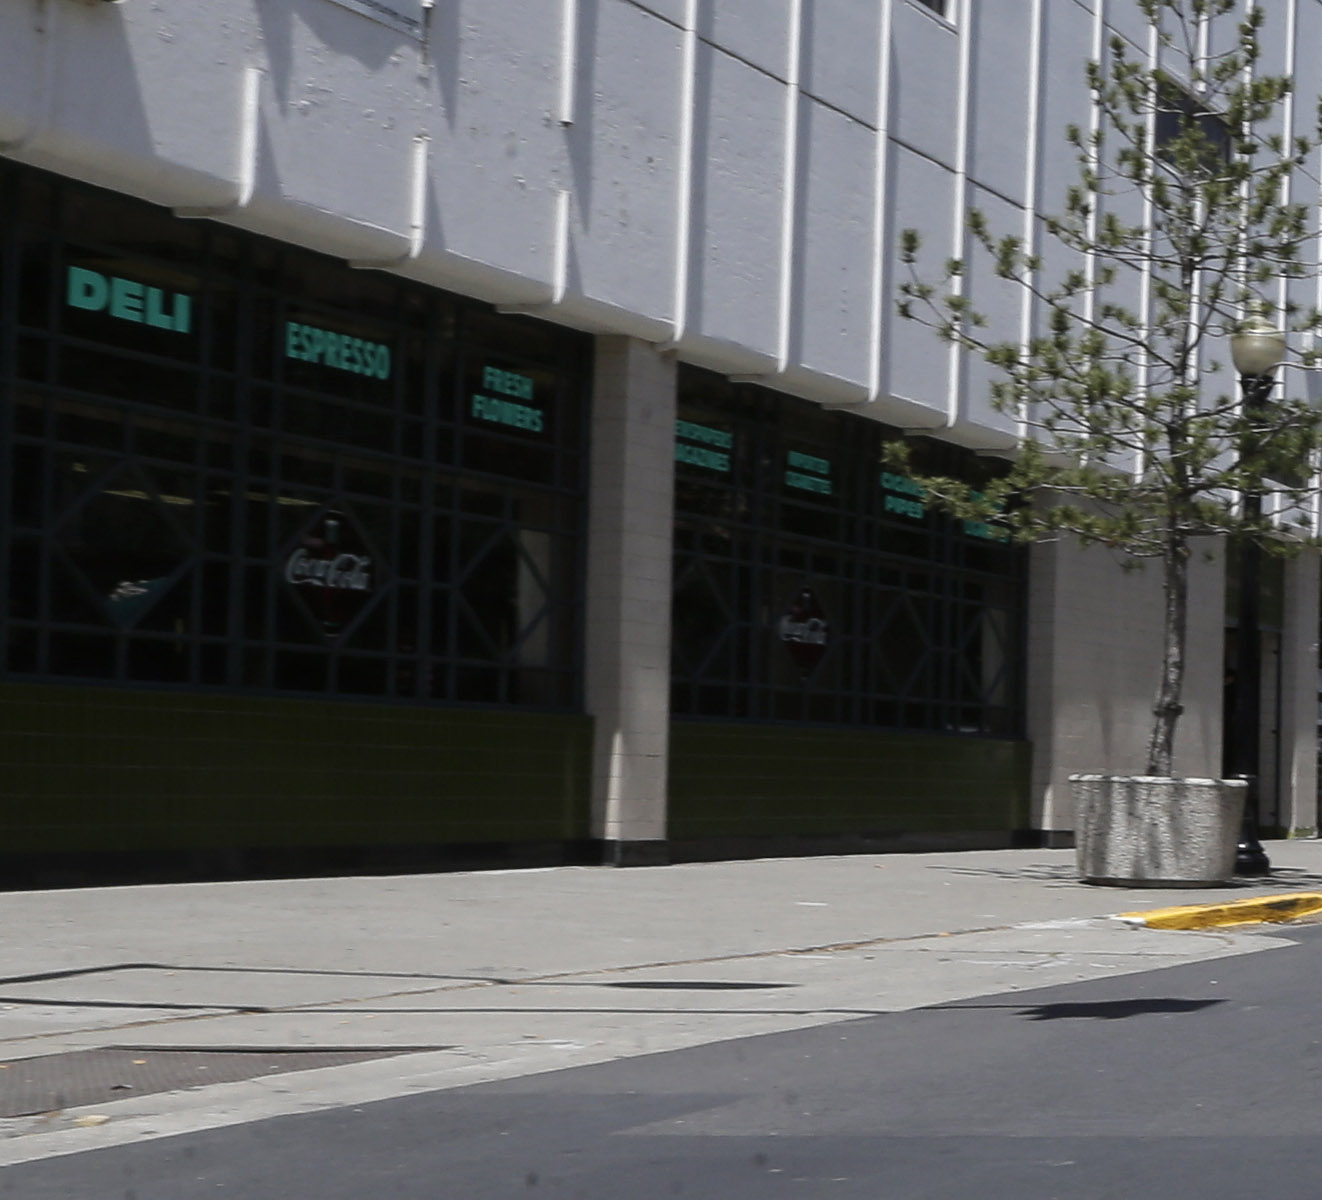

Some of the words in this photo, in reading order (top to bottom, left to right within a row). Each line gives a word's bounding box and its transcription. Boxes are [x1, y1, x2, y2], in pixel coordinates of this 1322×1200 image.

[67, 265, 192, 334] DELI
[285, 321, 391, 381] ESPRESSO
[482, 365, 534, 400] FRESH
[471, 394, 544, 432] FLOWERS
